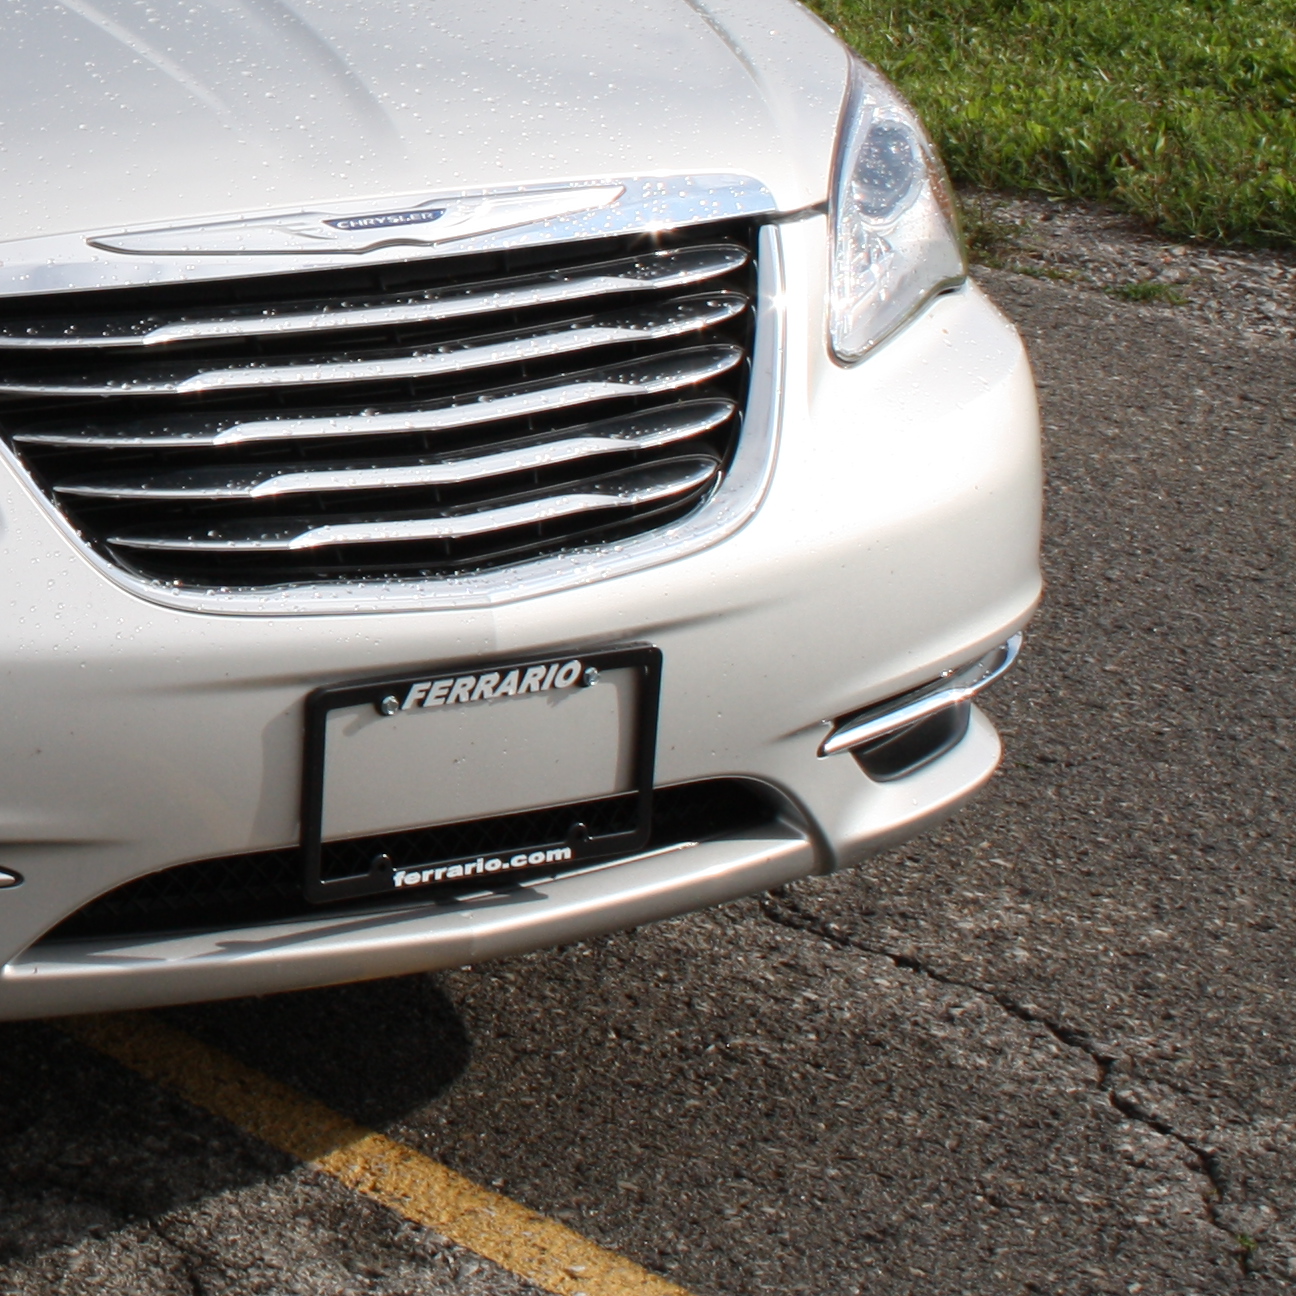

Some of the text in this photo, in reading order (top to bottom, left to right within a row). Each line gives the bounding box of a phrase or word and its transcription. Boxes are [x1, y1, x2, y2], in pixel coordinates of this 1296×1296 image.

[336, 211, 434, 229] CHRYSLER
[401, 659, 582, 711] FERRARIO
[393, 846, 572, 887] ferrario.com
